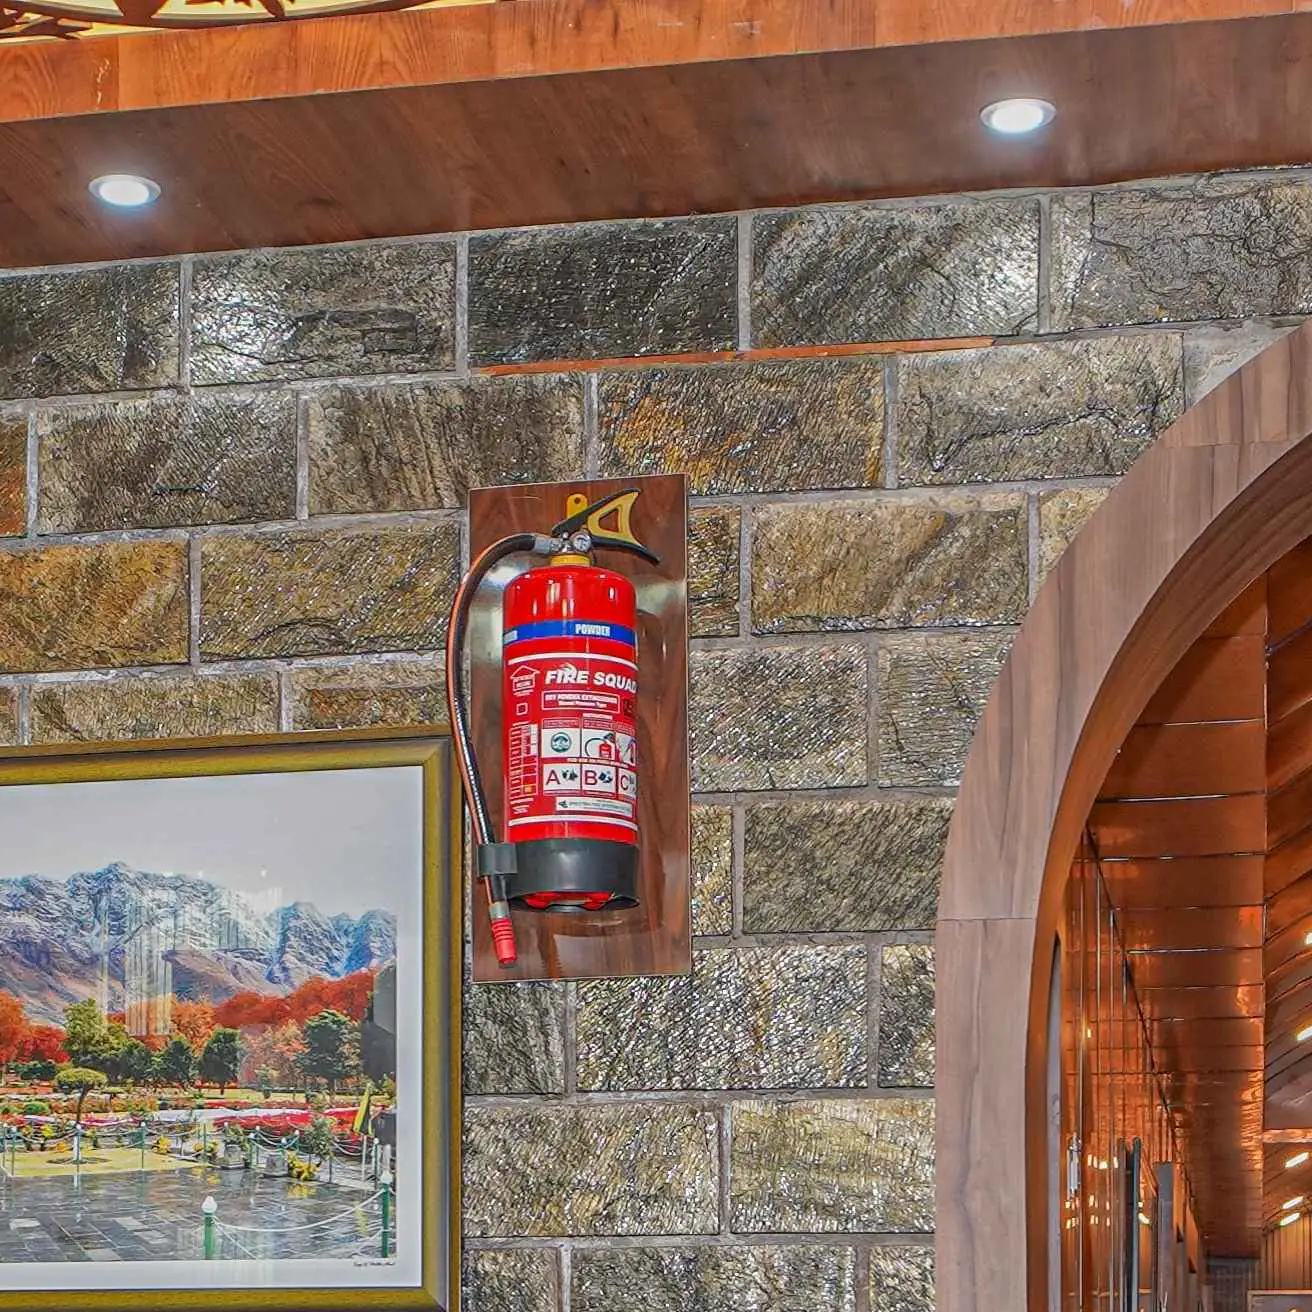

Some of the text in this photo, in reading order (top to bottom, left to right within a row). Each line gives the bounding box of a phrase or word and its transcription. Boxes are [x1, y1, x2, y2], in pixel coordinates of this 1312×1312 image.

[575, 624, 611, 637] POWDER
[545, 667, 589, 685] FIRE
[545, 769, 561, 786] A
[585, 769, 598, 786] B
[620, 774, 629, 791] C
